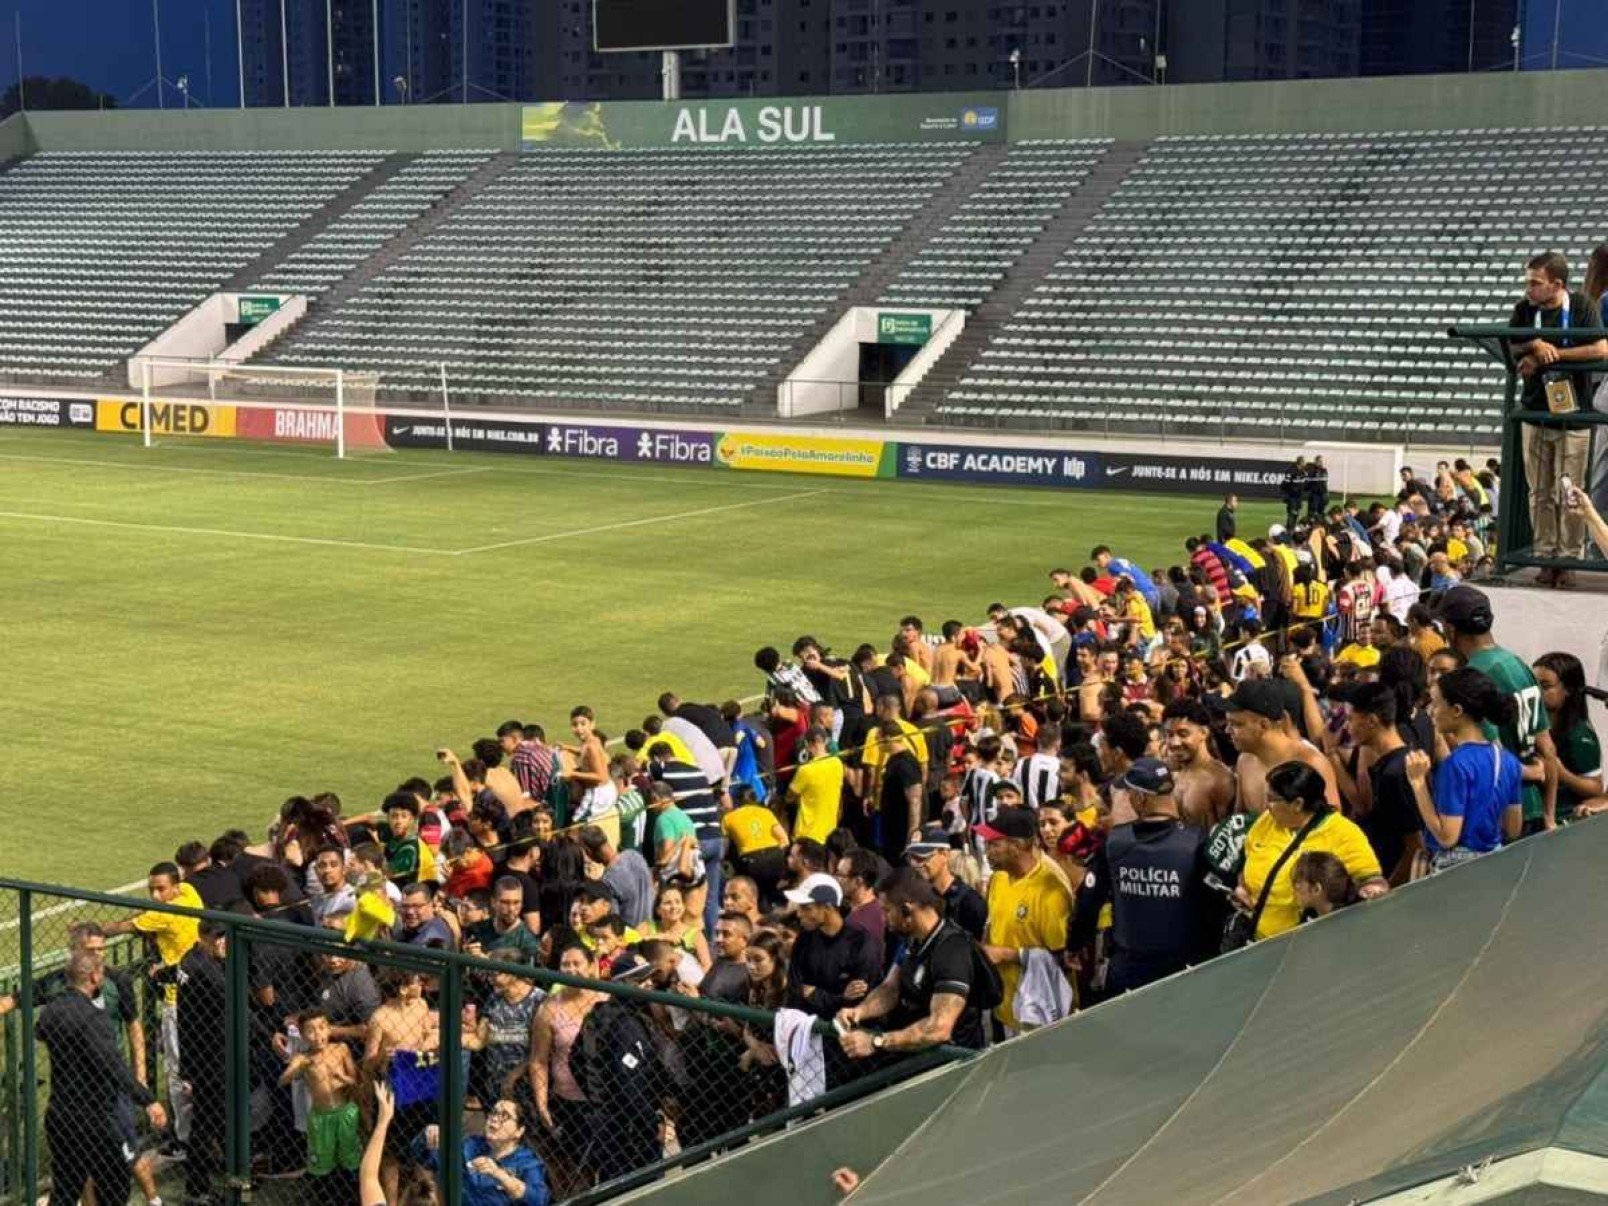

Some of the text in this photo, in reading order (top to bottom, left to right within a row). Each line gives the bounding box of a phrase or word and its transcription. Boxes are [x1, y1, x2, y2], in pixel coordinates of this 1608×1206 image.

[670, 106, 836, 142] ALA SUL
[120, 401, 210, 433] CIMED
[275, 410, 340, 440] BRAHMA
[564, 428, 618, 456] Fibra
[655, 434, 711, 462] Fibra
[925, 452, 961, 470] CBF
[964, 453, 1057, 474] ACADEMY
[1132, 465, 1176, 479] JUNTE-SE
[1179, 468, 1187, 480] A
[1190, 466, 1211, 482] NÓS
[1214, 470, 1231, 482] EM
[1119, 865, 1180, 884] POLÍCIA
[1119, 883, 1181, 898] MILITAR
